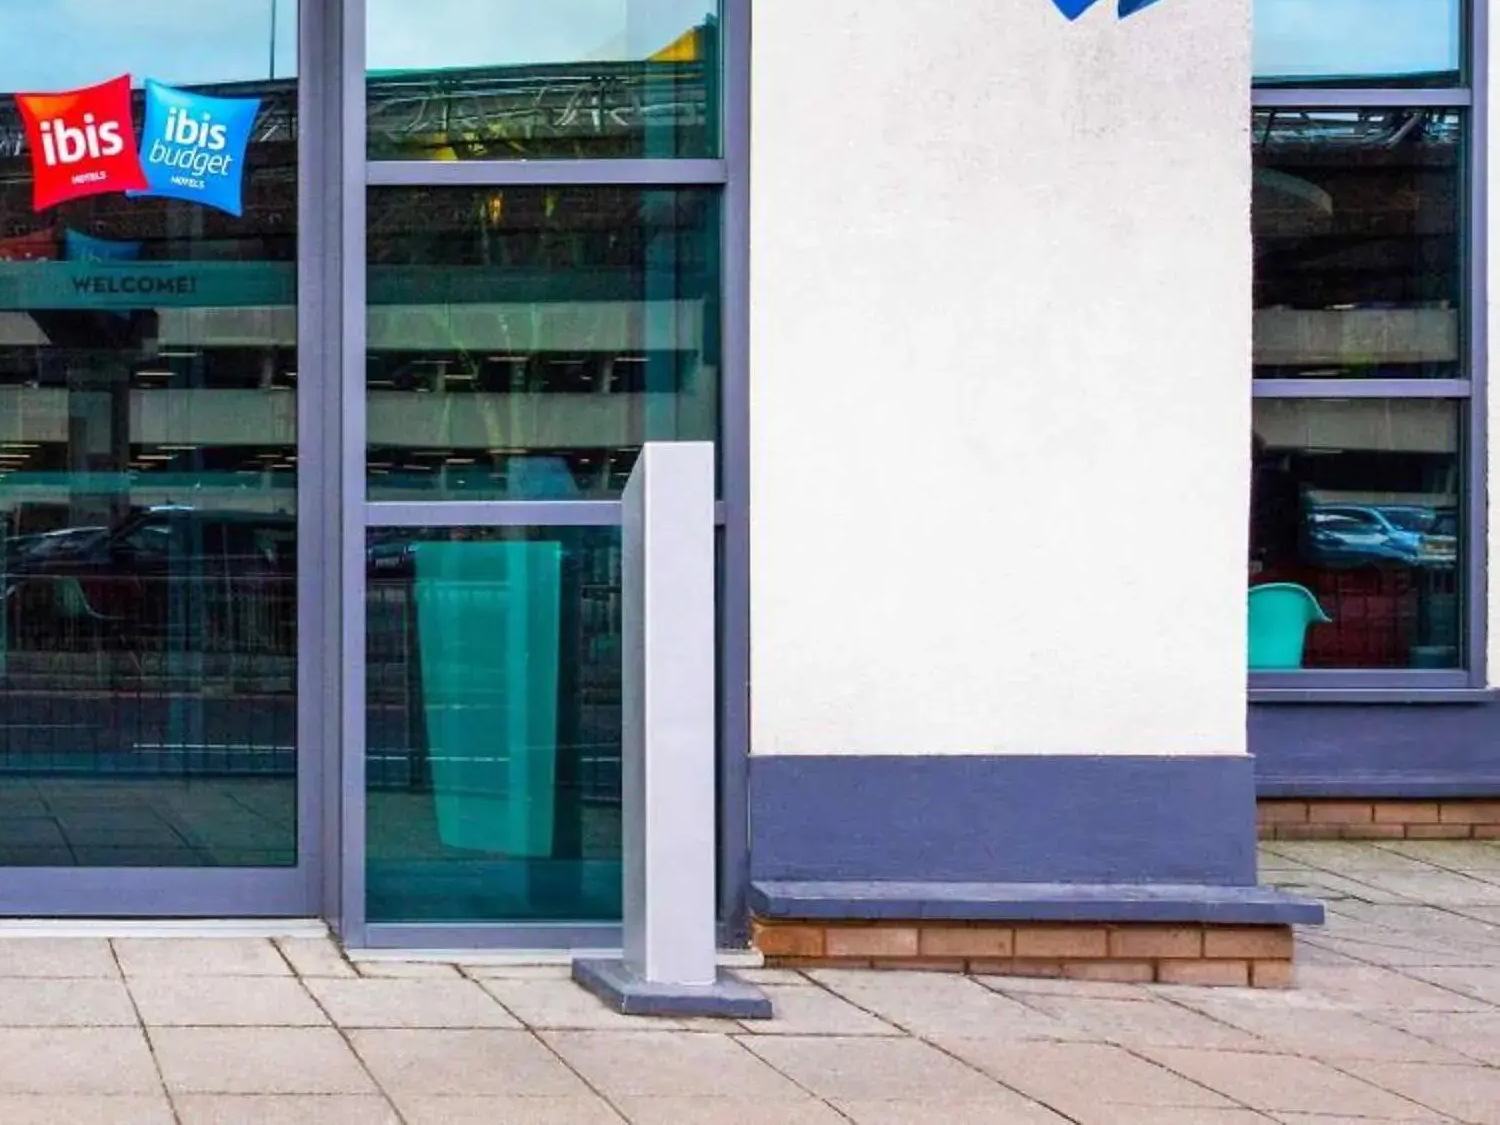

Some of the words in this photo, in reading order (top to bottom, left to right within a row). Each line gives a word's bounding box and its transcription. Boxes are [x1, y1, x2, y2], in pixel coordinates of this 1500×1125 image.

[40, 112, 124, 166] ibis
[165, 106, 227, 151] ibis
[149, 139, 233, 176] budget
[72, 276, 197, 294] WELCOME!
